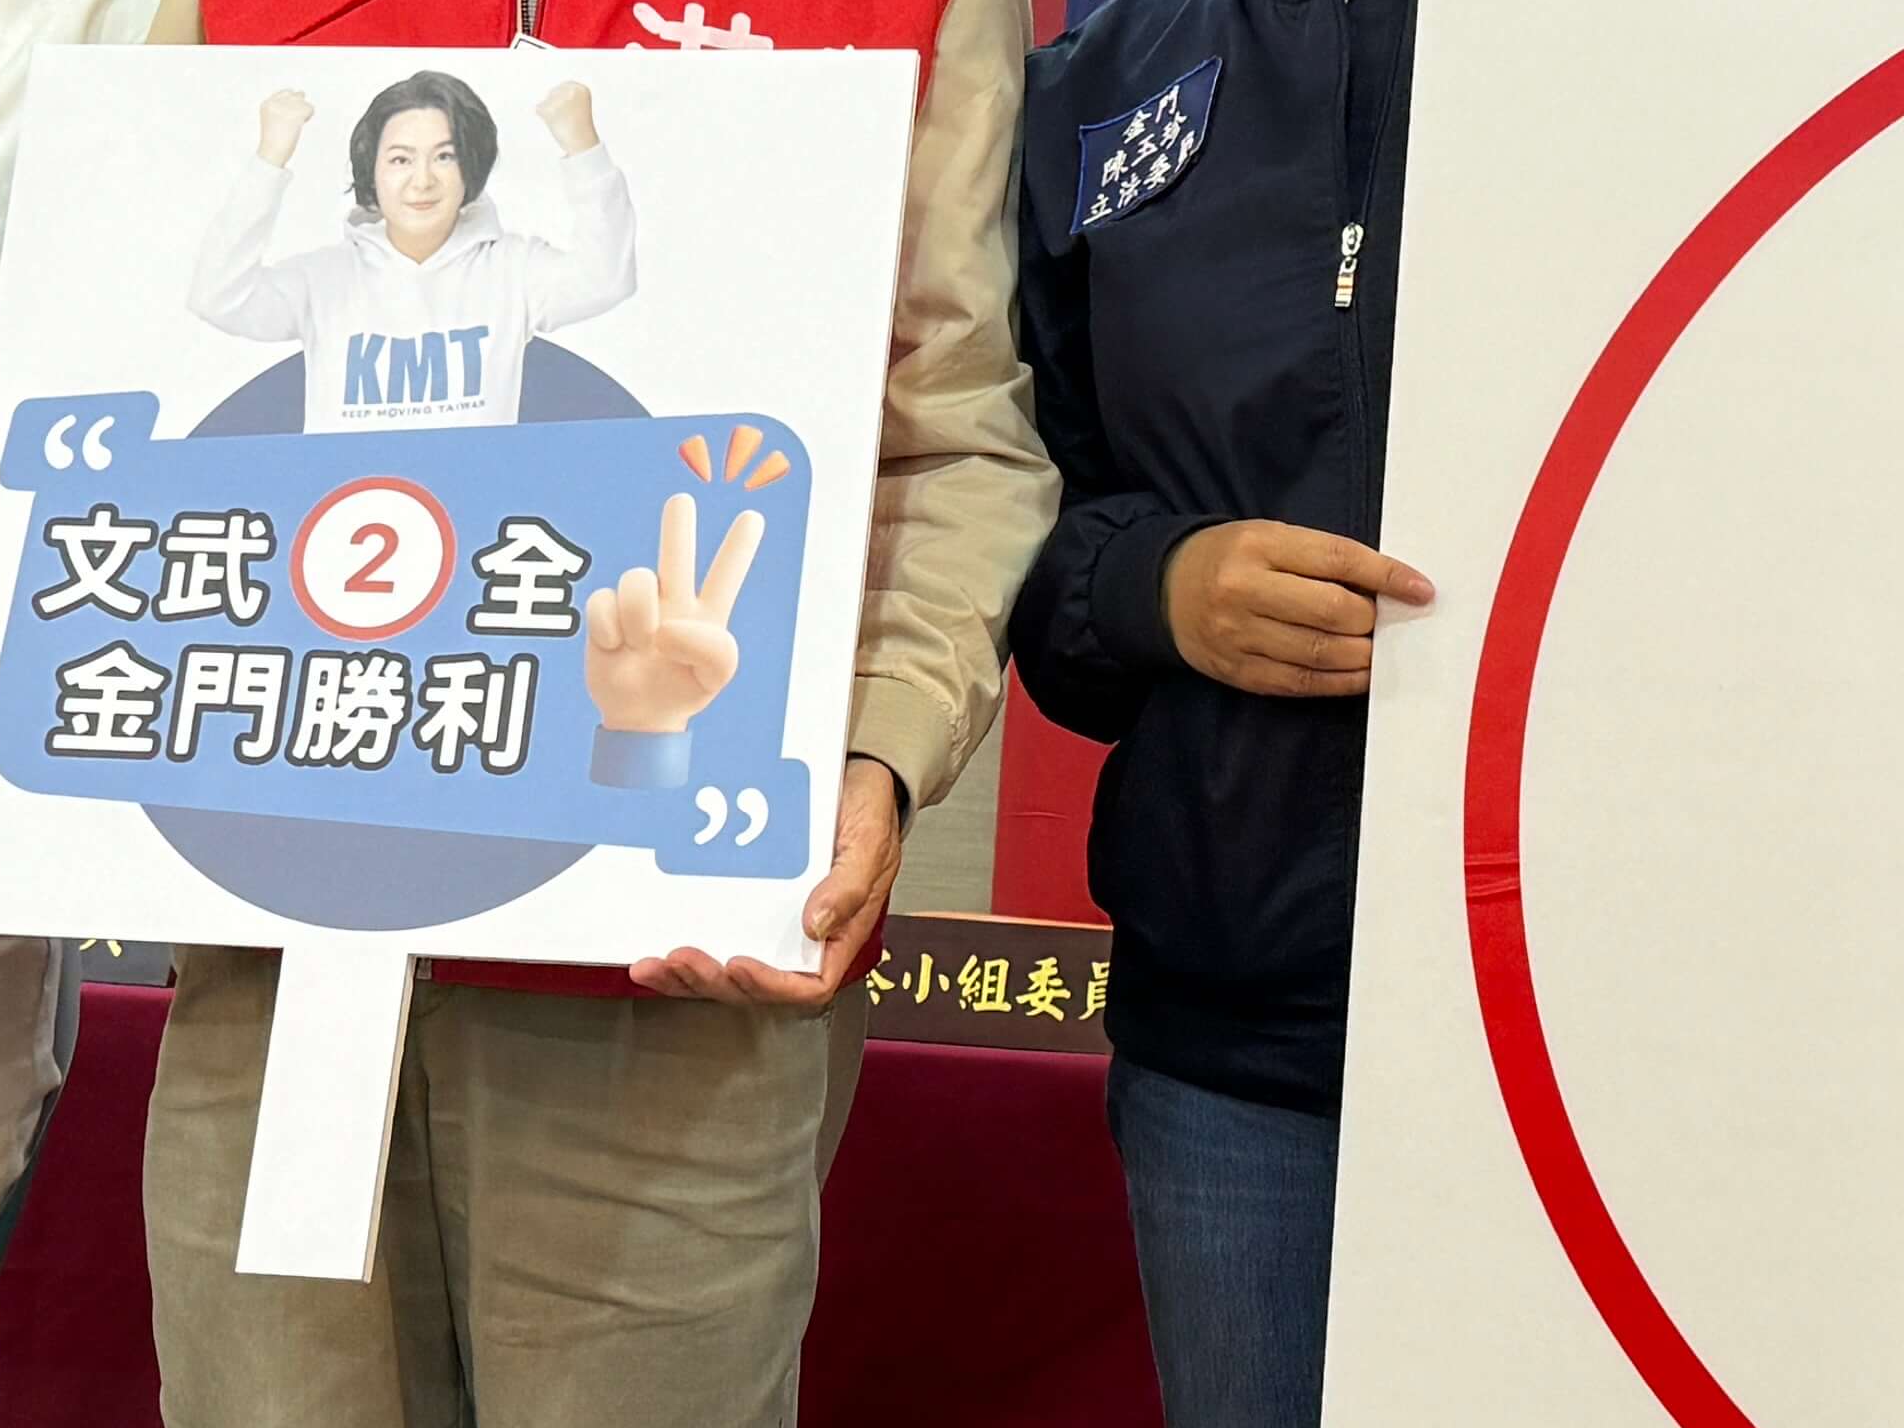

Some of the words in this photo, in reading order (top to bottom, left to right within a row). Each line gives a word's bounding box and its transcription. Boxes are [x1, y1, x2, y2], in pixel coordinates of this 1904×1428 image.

[343, 325, 489, 405] KMT
[46, 638, 540, 776] 金門勝利
